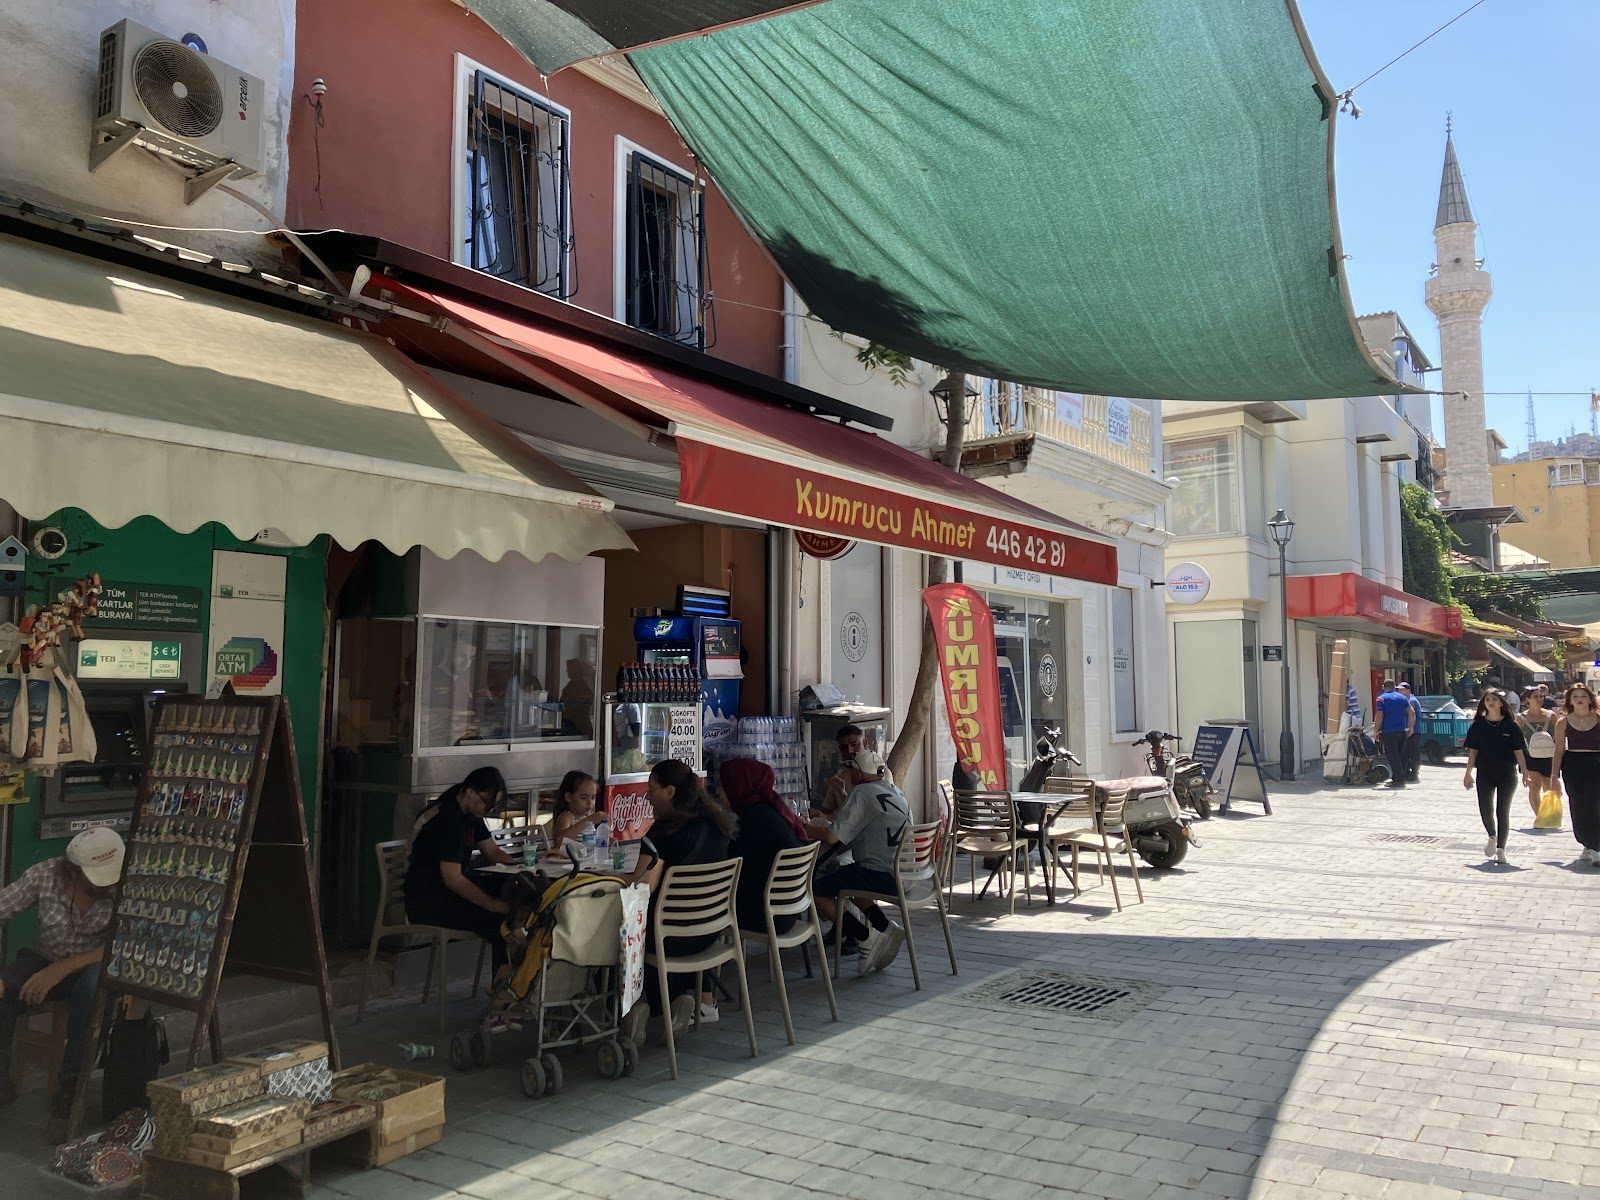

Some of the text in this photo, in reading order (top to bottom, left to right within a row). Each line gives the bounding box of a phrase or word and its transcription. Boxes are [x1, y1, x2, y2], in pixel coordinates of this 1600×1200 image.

[1108, 418, 1129, 440] ESNAF
[795, 478, 1066, 568] Kumrucu Ahmet 446 42 81
[106, 588, 126, 598] TÜM
[97, 599, 134, 609] KARTLAR
[98, 610, 133, 620] BURAYA!
[153, 646, 159, 656] $
[162, 647, 169, 656] €
[217, 653, 246, 662] ORTAK
[217, 661, 246, 674] ATM
[671, 725, 695, 736] 40.00
